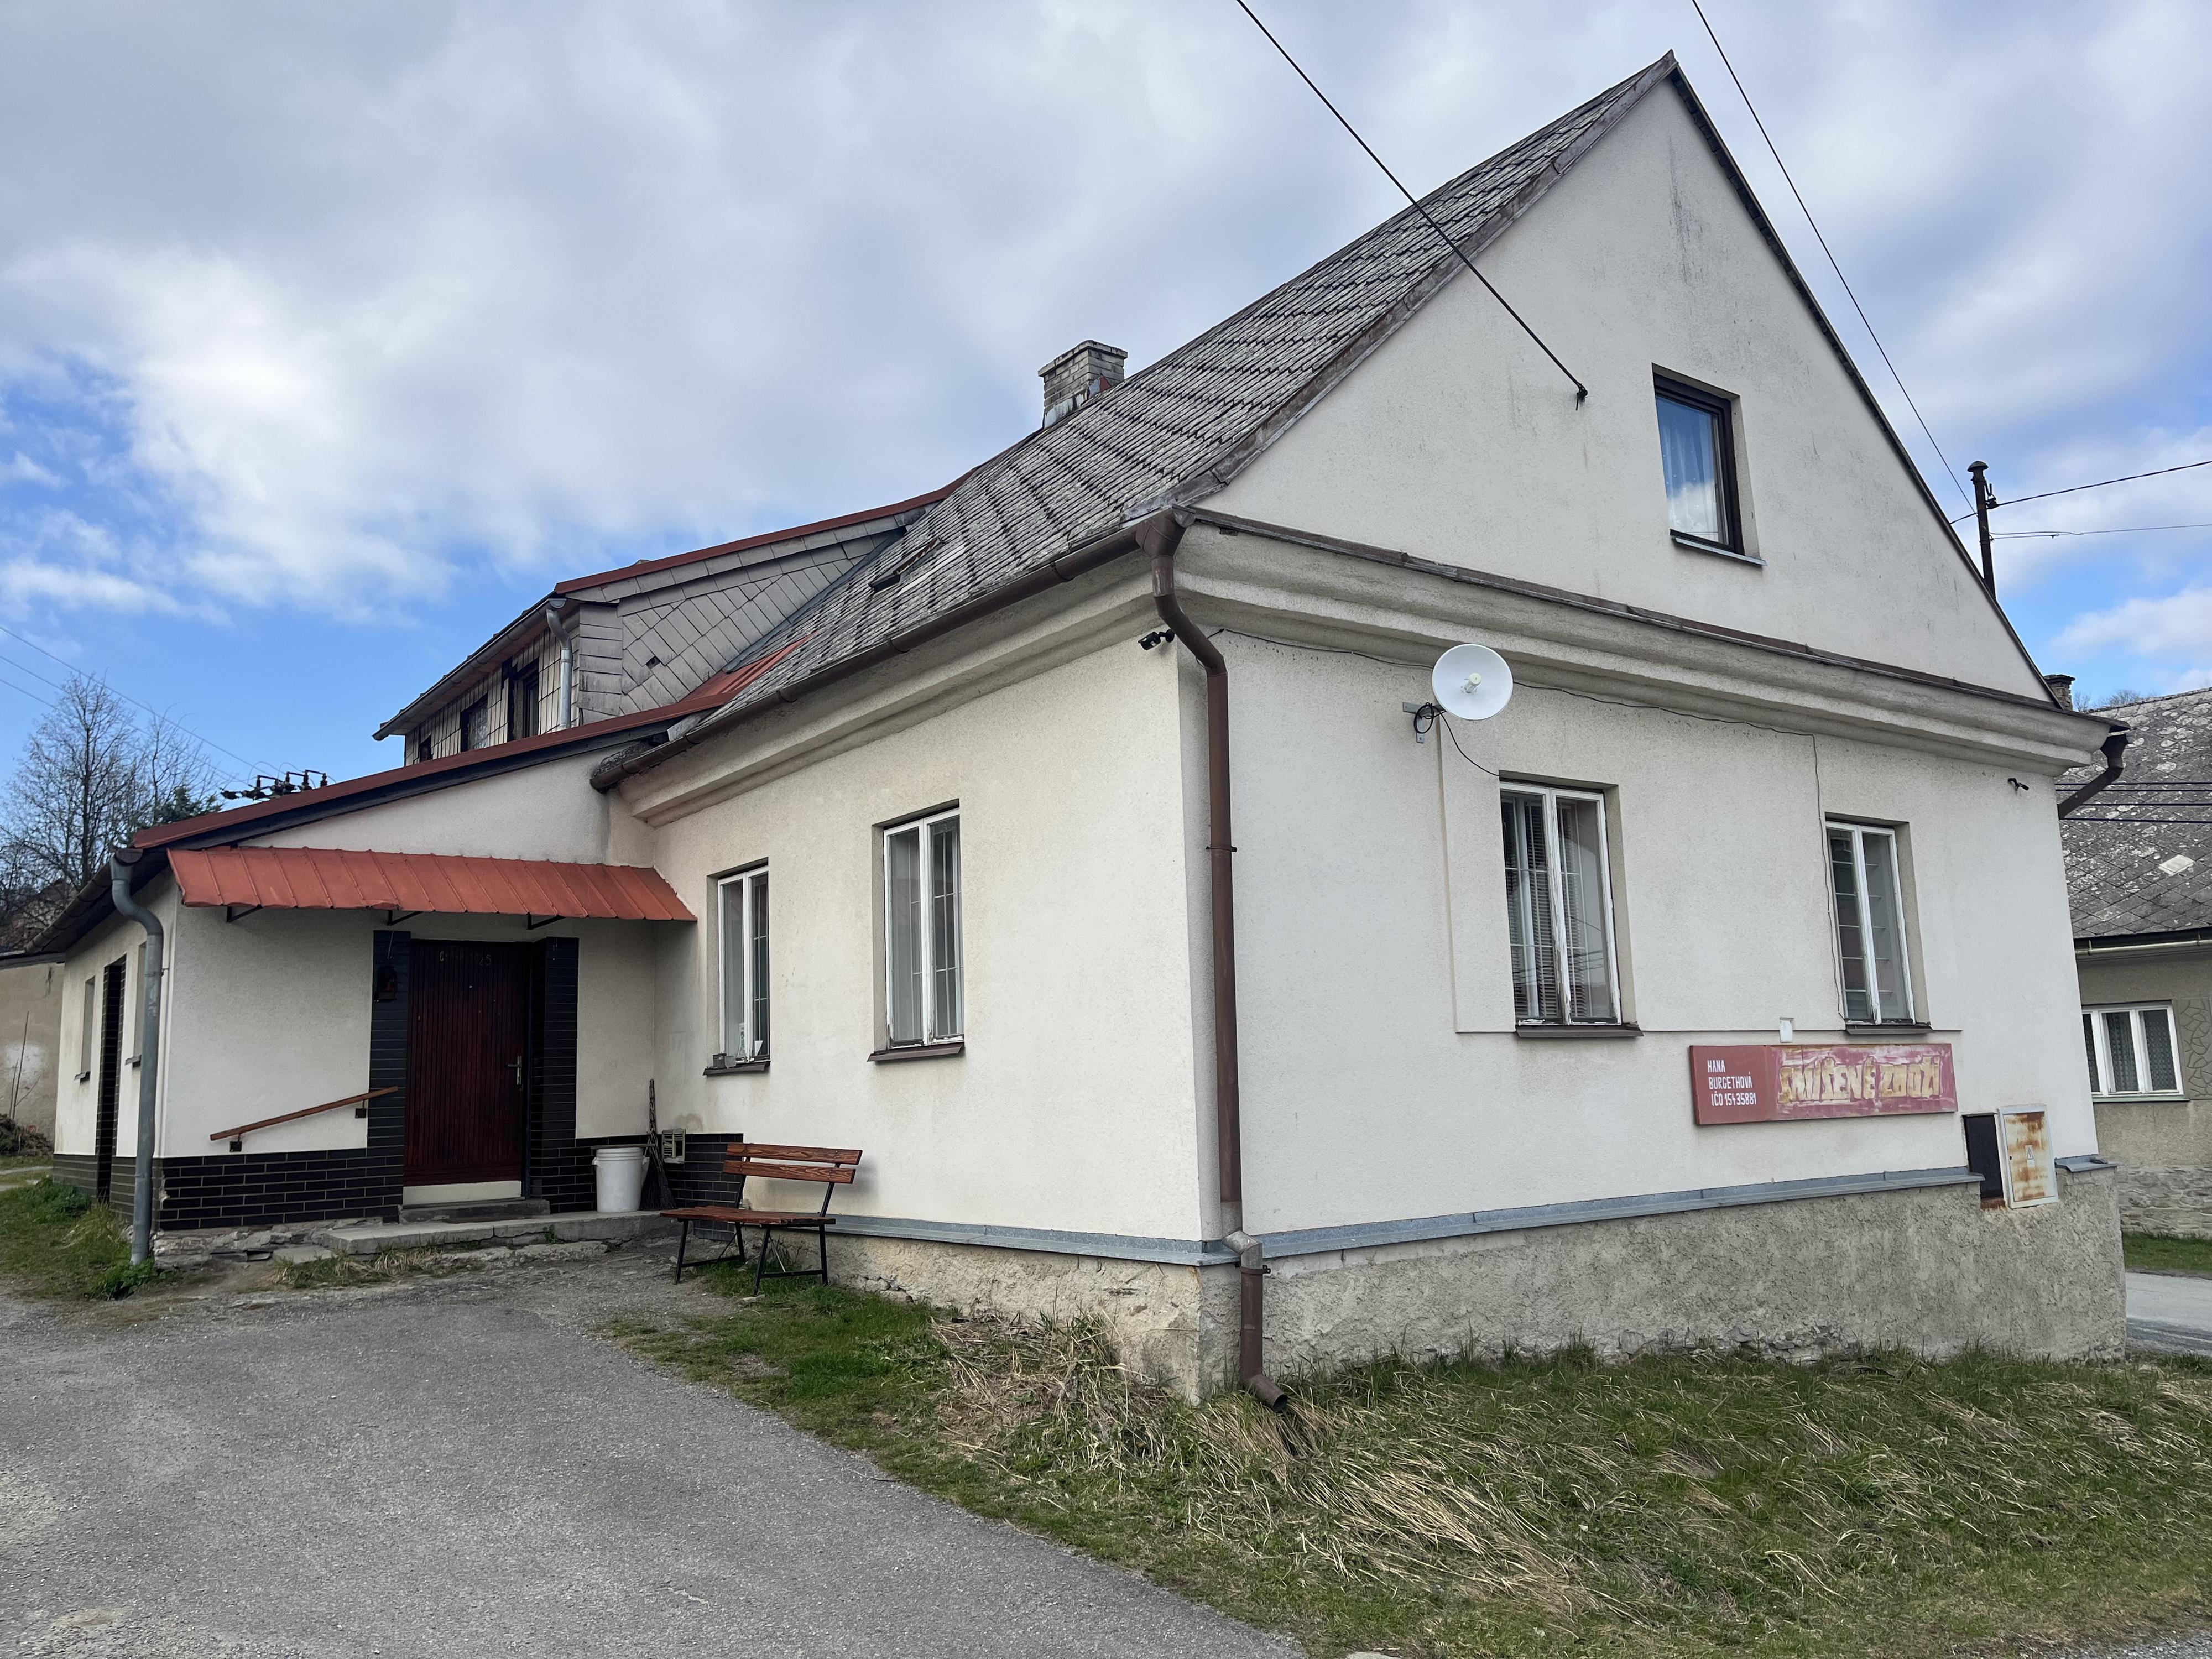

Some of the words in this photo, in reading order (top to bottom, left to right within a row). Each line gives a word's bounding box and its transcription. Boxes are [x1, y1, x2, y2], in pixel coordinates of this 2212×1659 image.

[1707, 1060, 1726, 1073] HANA
[1708, 1071, 1753, 1089] BURGETHOVÁ
[1712, 1091, 1723, 1106] IČO
[1725, 1092, 1757, 1106] 15435881
